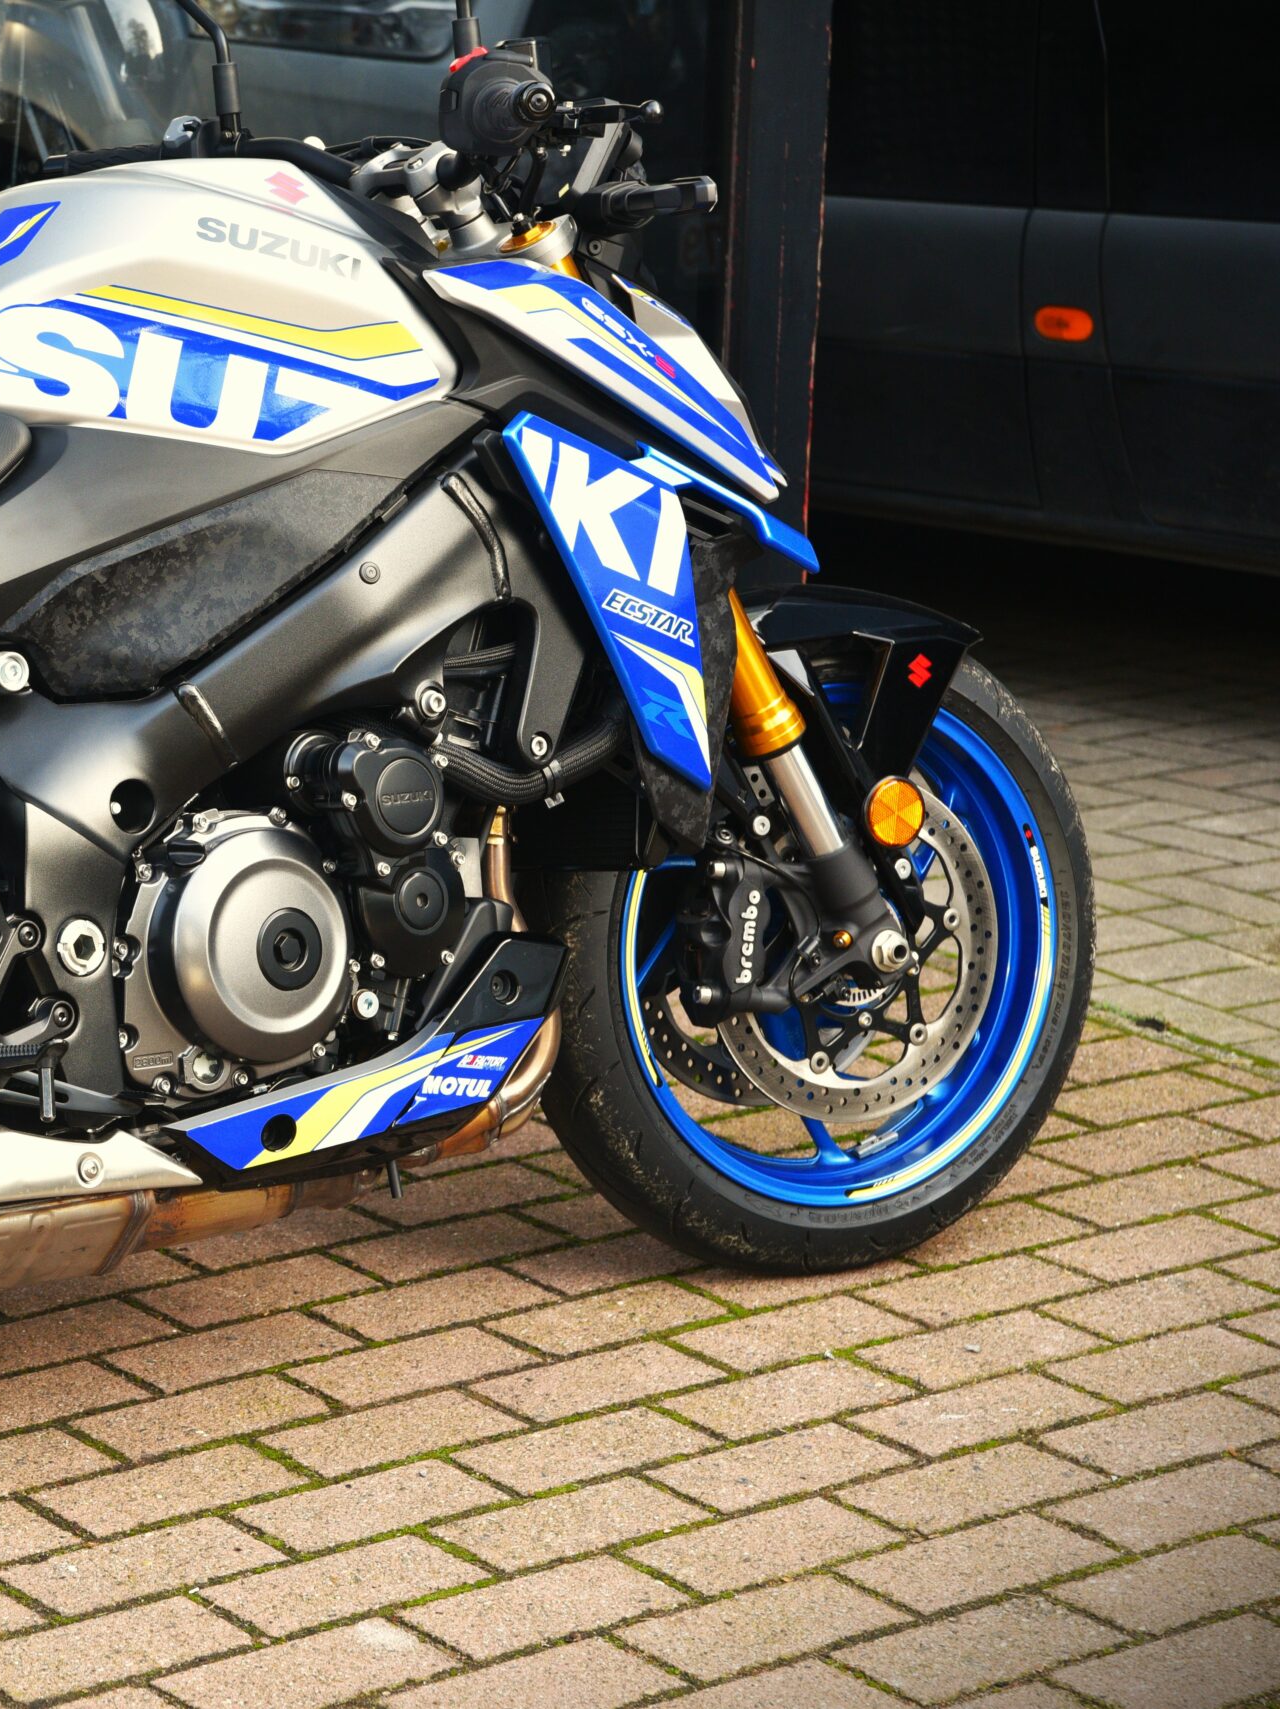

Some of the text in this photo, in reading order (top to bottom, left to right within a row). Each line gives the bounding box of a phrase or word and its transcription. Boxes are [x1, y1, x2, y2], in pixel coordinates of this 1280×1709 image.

[195, 216, 362, 281] SUZUKI
[581, 296, 677, 379] GSX-S
[602, 588, 696, 648] ECSTAR
[381, 789, 434, 806] SUZUKI
[735, 889, 761, 984] brembo
[422, 1074, 493, 1098] MOTUL
